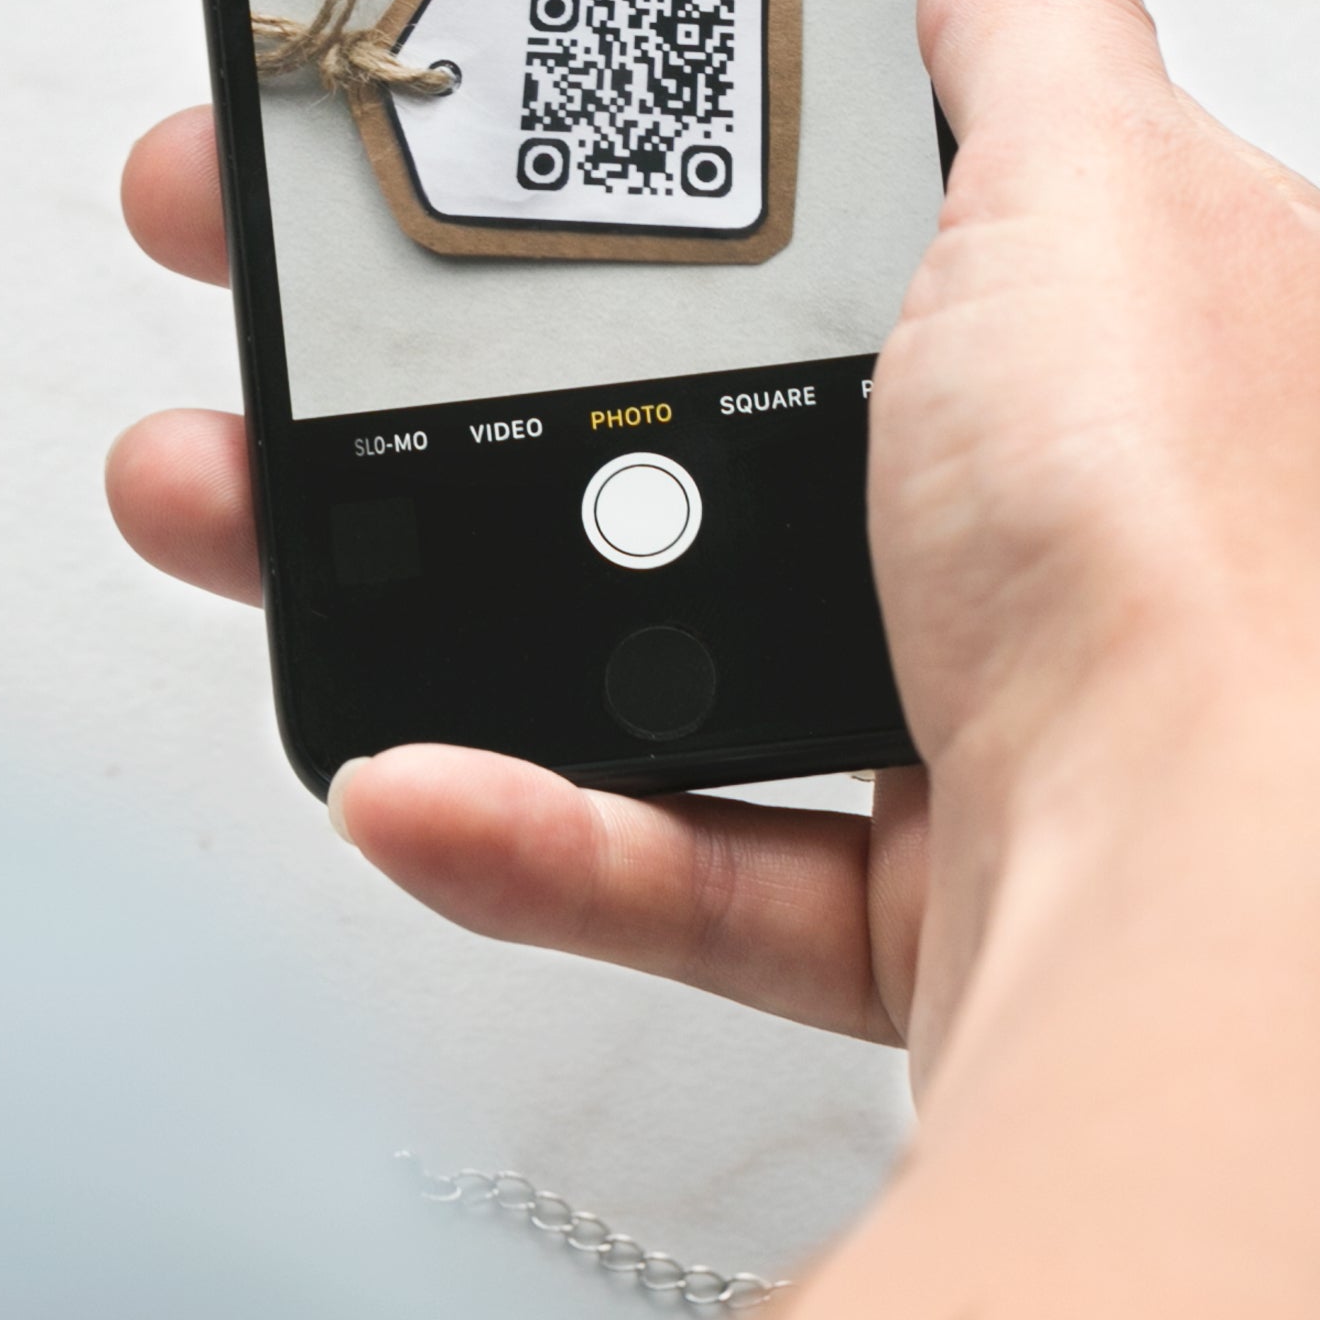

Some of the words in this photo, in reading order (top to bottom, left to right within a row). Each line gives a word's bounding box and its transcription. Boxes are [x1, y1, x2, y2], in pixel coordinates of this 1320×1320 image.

[354, 430, 429, 457] SLO-MO
[470, 418, 543, 443] VIDEO
[591, 404, 672, 430] PHOTO
[720, 386, 817, 415] SQUARE
